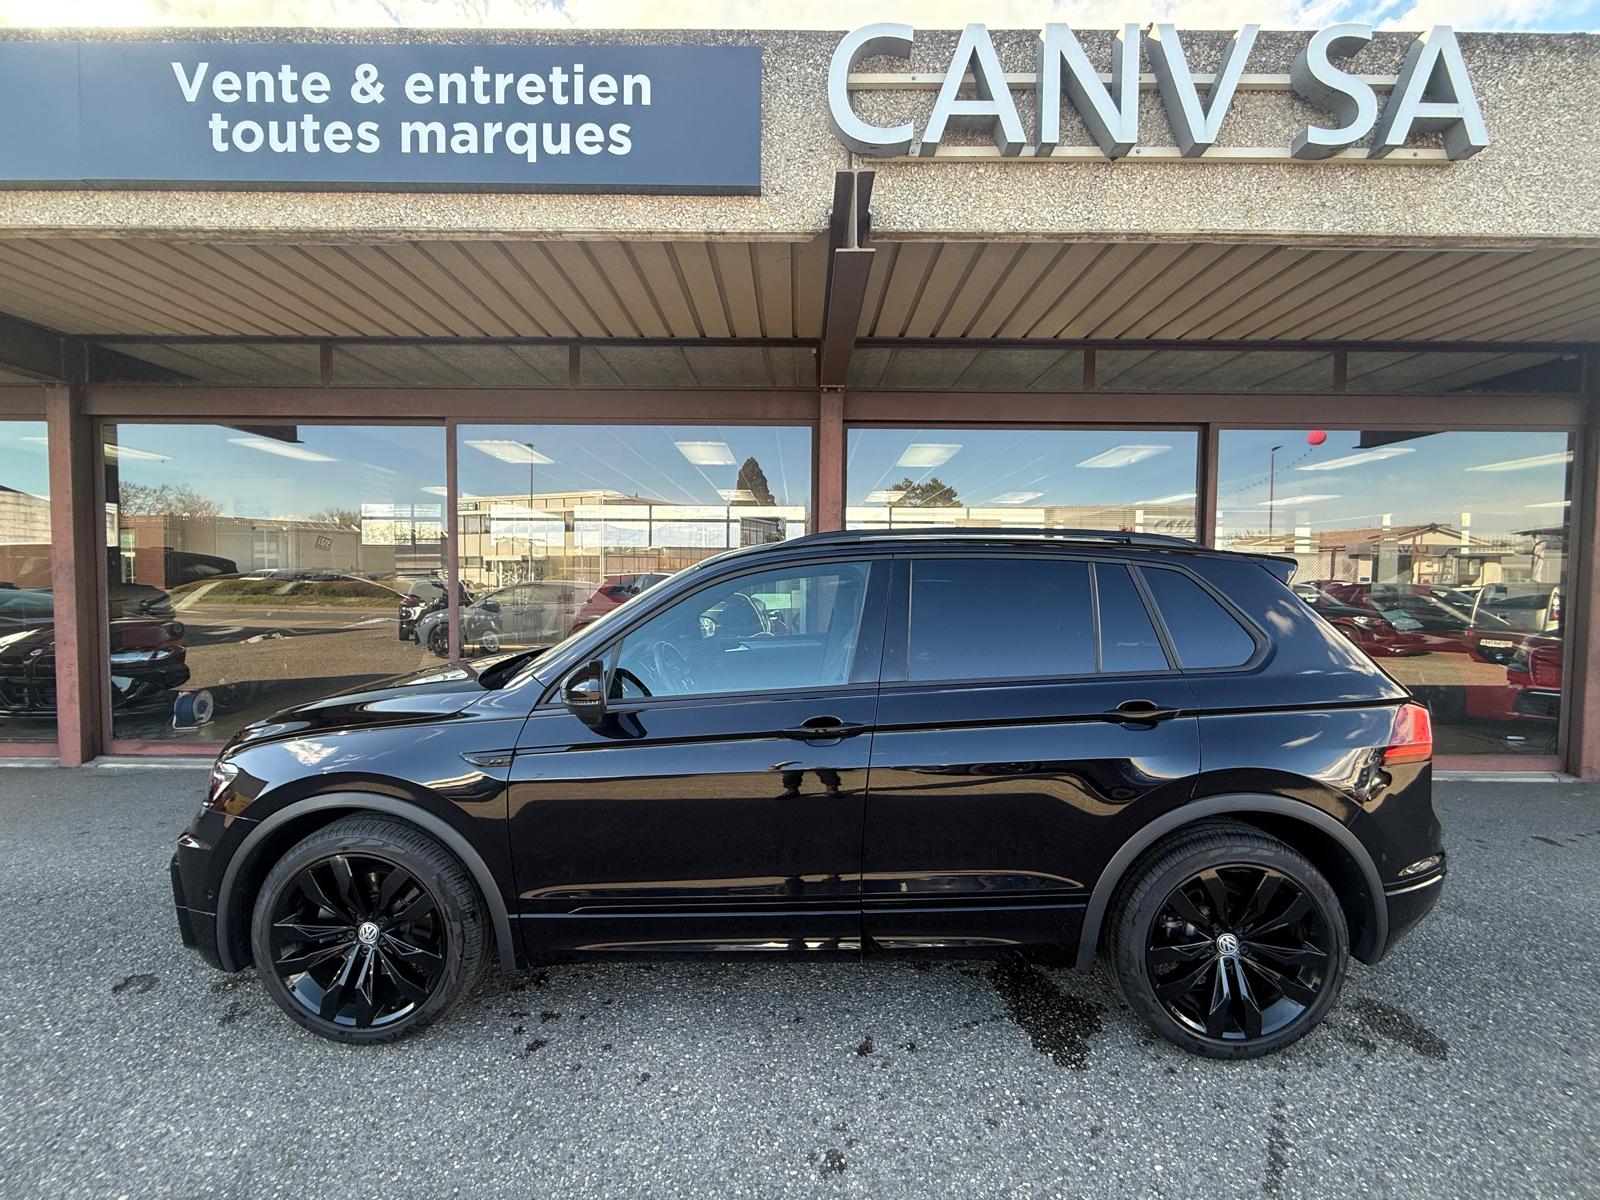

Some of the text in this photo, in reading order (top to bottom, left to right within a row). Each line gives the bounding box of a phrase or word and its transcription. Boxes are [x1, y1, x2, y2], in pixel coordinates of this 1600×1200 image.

[170, 61, 652, 106] Vente & entretien
[827, 22, 1490, 150] CANV SA
[208, 112, 632, 163] toutes marques
